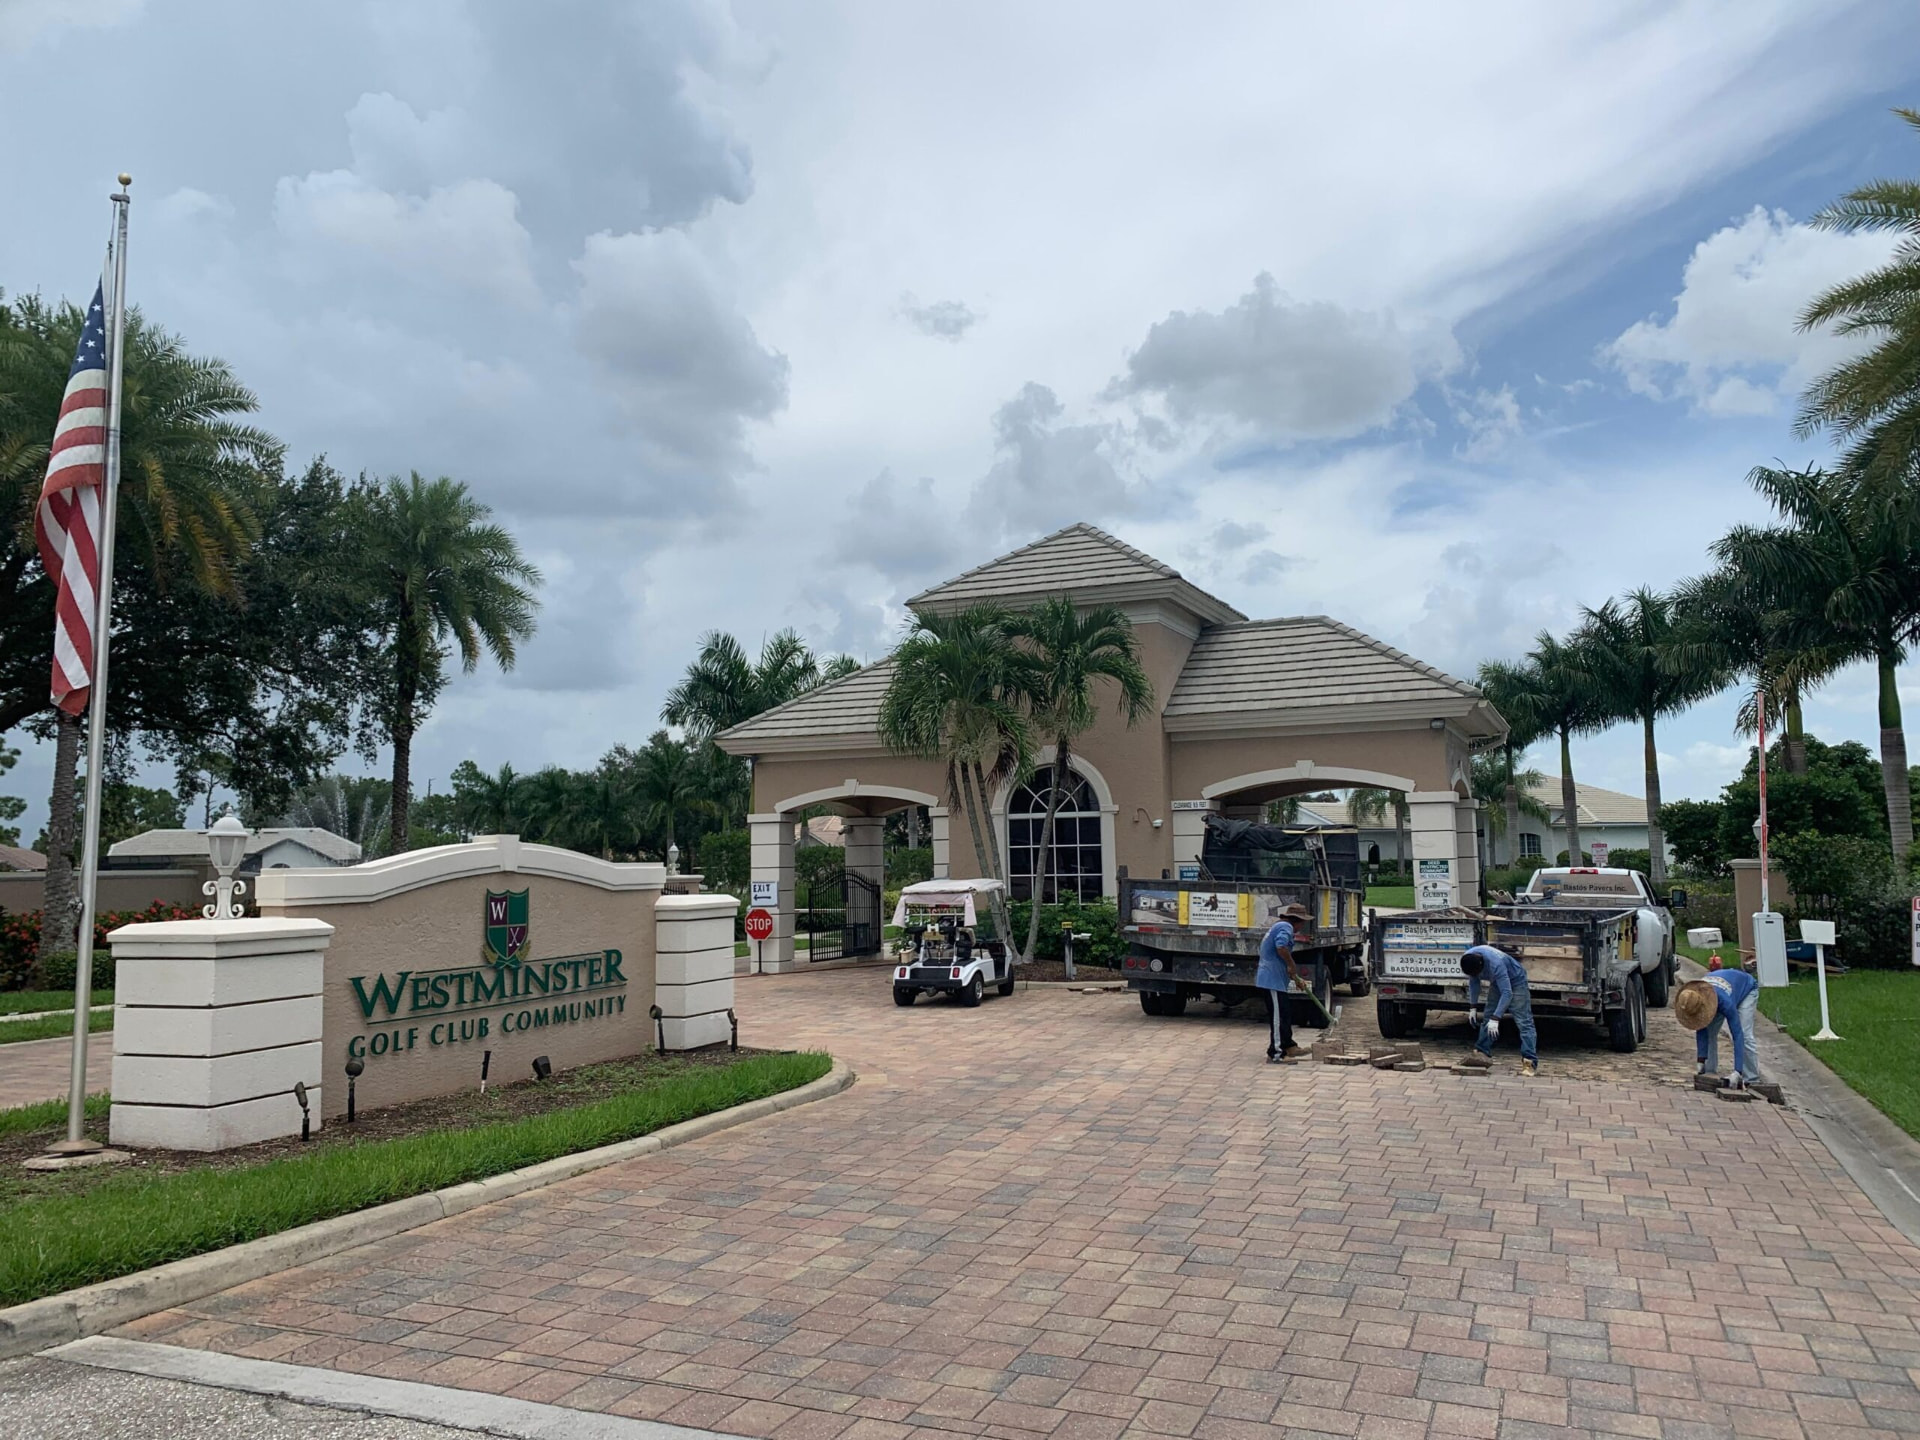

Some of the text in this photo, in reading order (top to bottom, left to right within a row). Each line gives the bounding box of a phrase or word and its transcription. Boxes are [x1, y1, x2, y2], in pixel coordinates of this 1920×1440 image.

[753, 884, 770, 892] EXIT
[491, 901, 506, 921] W
[747, 918, 771, 931] STOP
[1429, 925, 1452, 934] Pavers
[1390, 965, 1461, 974] BASTOSPAVERS.CO
[348, 949, 628, 1018] WESTMINSTER
[349, 994, 628, 1058] GOLF CLUB COMMUNITY
